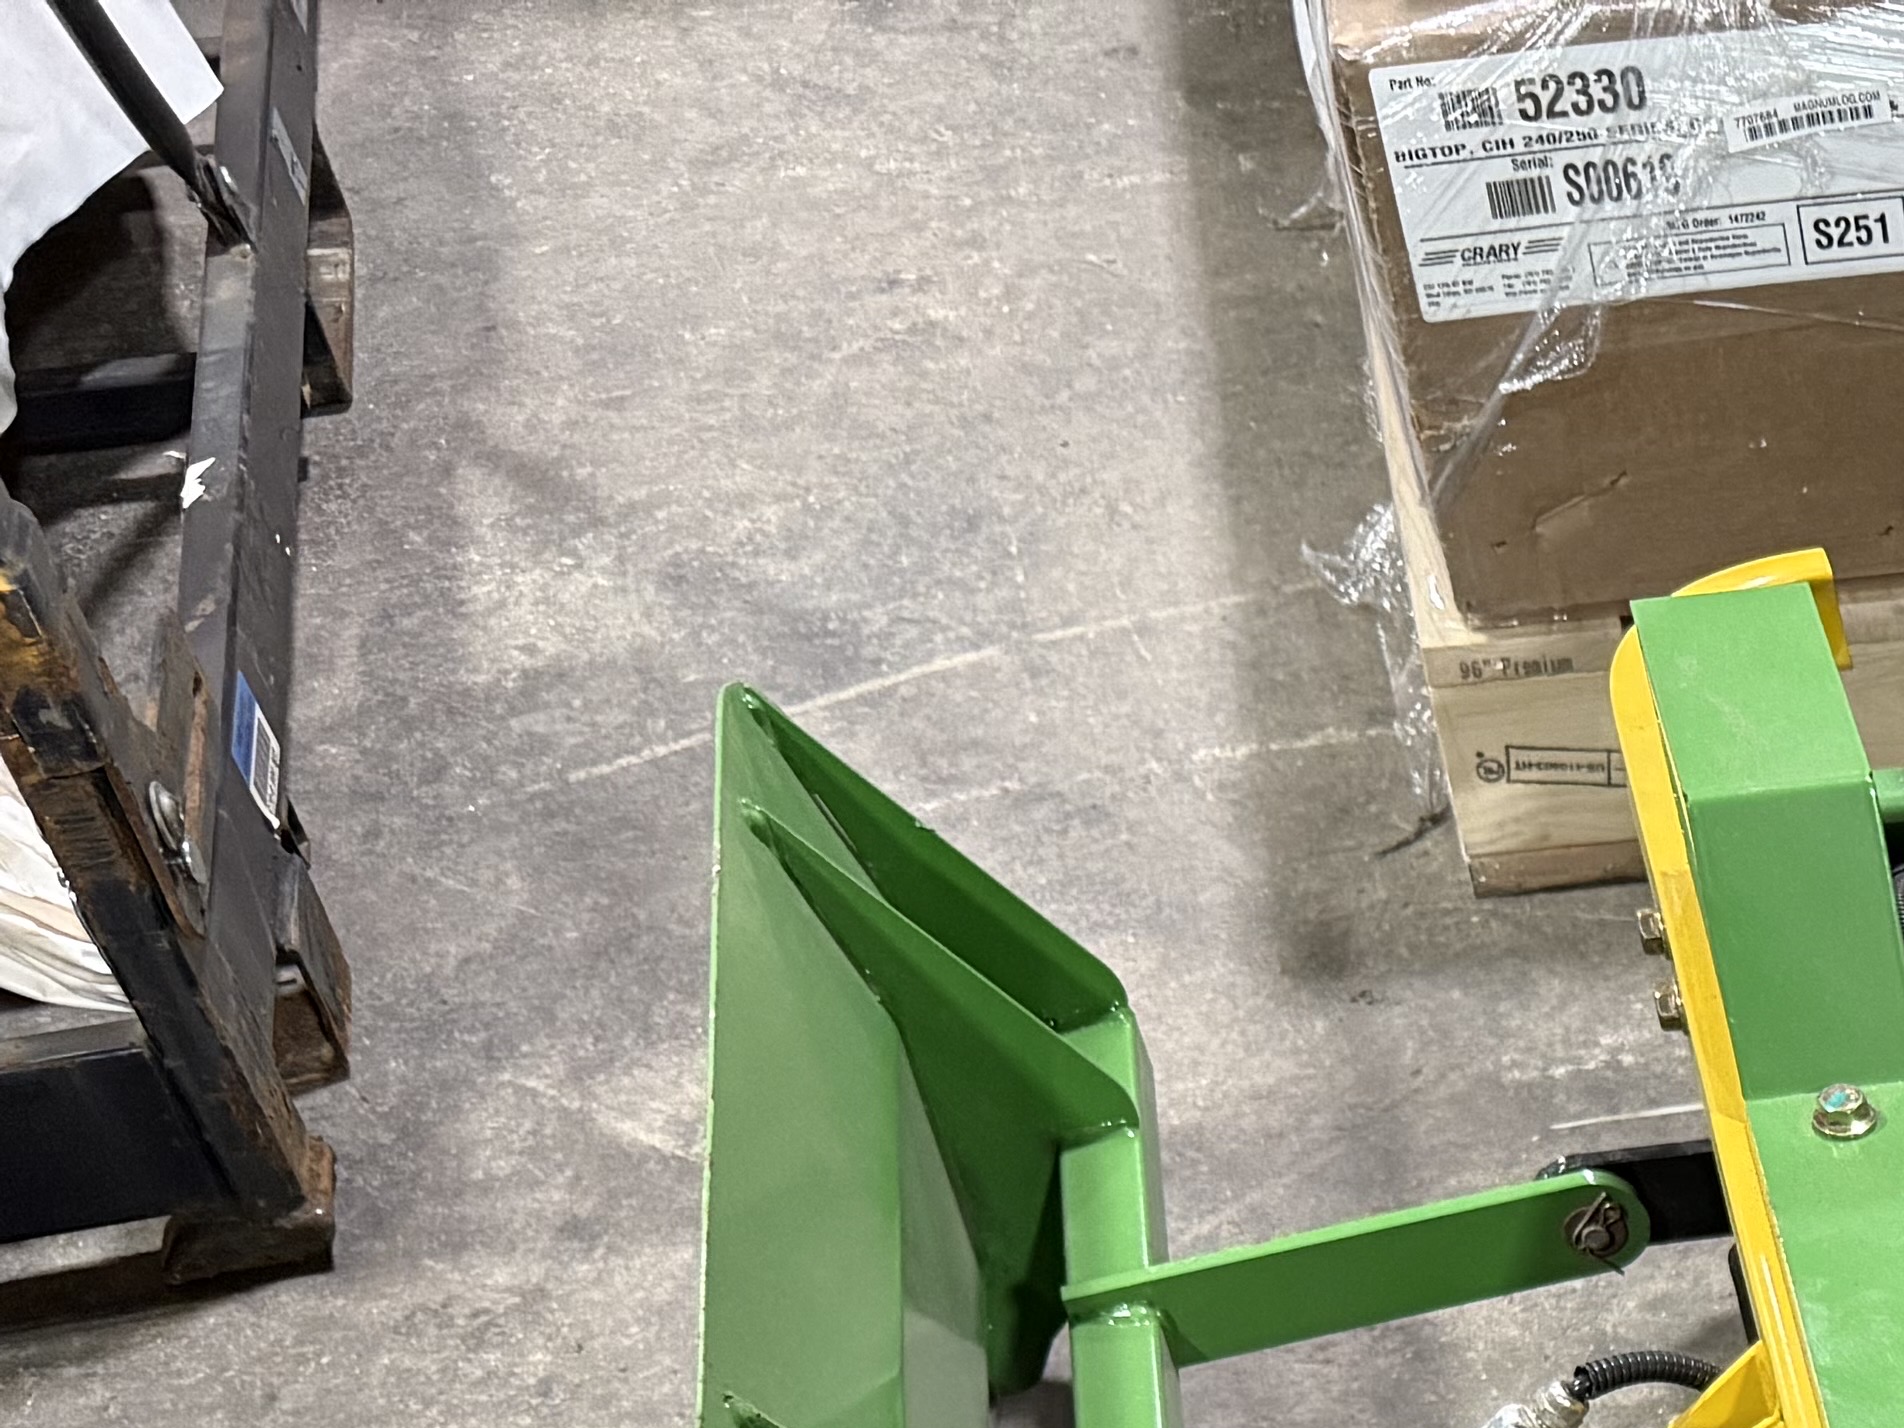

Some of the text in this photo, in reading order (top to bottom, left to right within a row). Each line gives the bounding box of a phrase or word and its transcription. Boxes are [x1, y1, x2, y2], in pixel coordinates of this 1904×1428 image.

[1389, 76, 1413, 92] Part
[1514, 65, 1647, 122] 52330
[1511, 155, 1554, 172] Serial:
[1812, 211, 1890, 251] S251
[1460, 241, 1521, 263] CRARY
